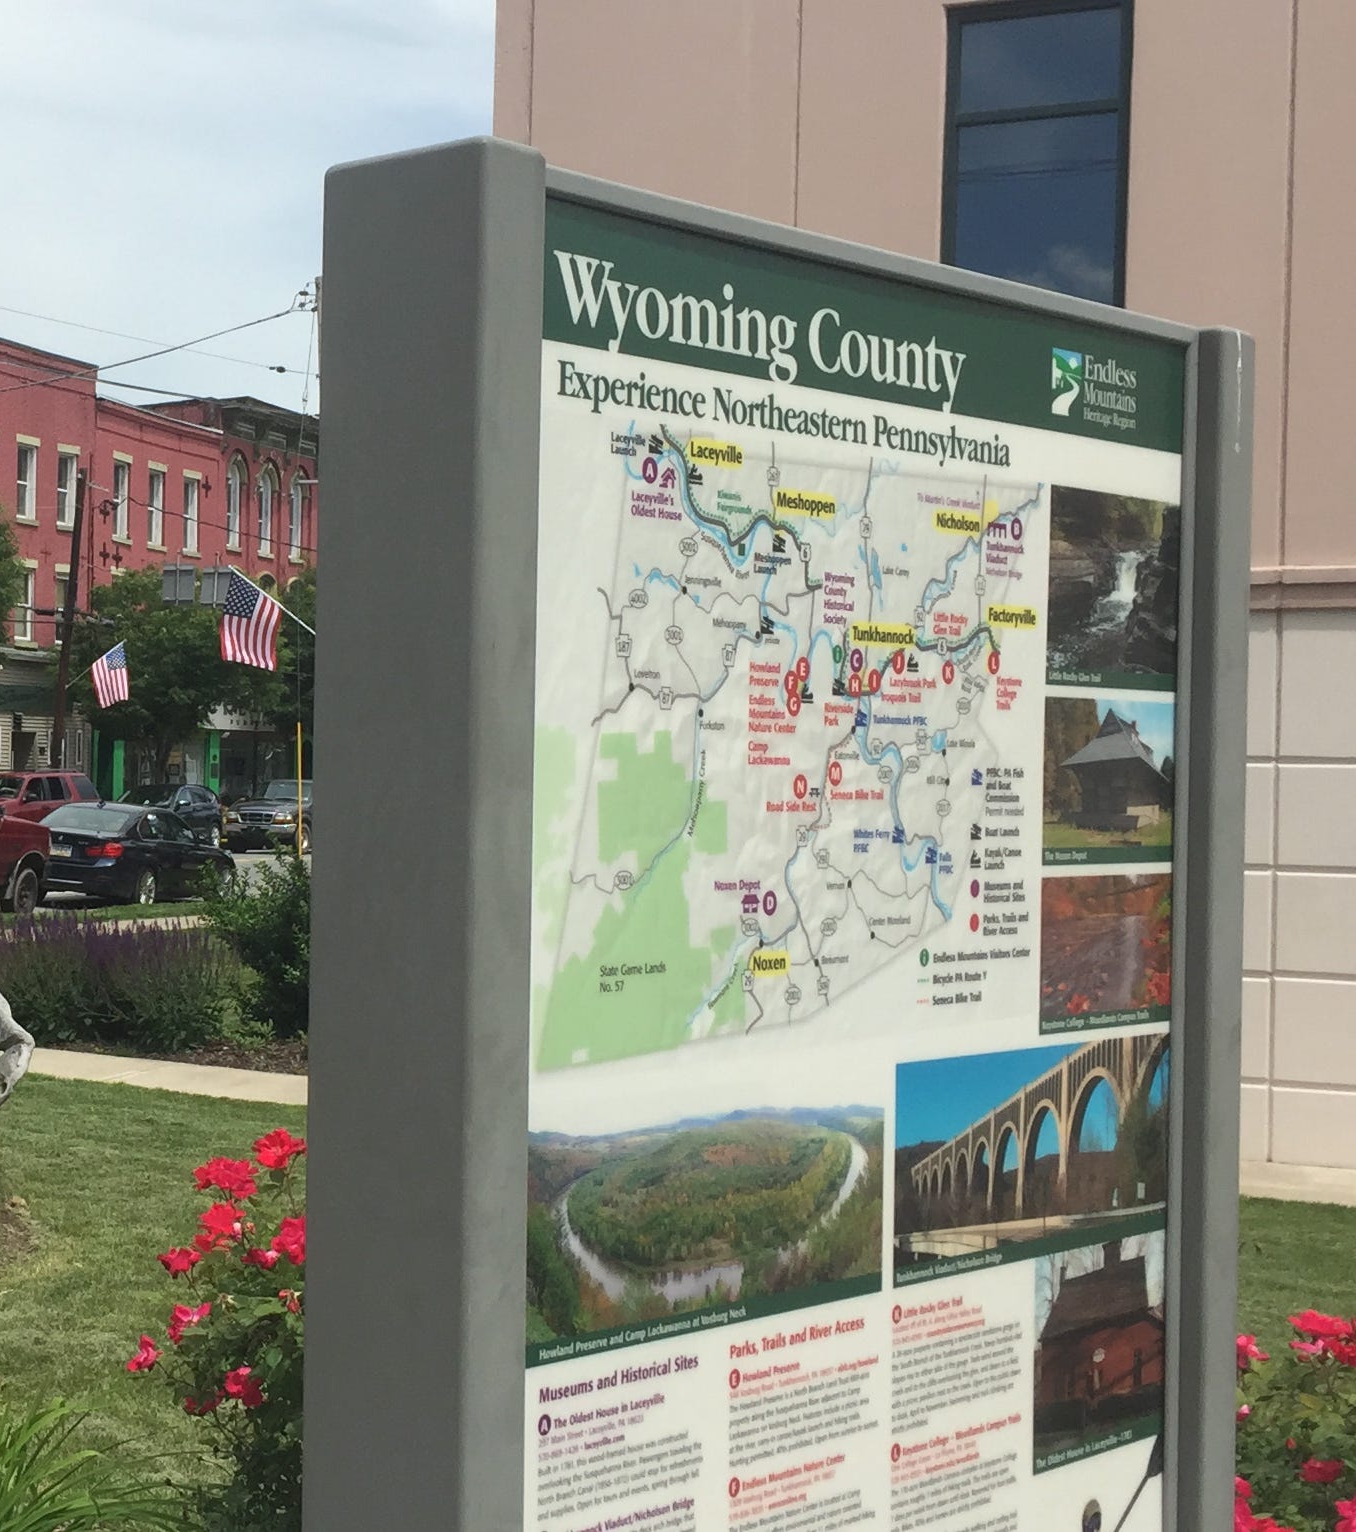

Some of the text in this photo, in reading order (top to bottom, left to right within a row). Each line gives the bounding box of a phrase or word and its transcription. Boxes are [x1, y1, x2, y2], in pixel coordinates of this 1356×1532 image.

[553, 250, 966, 412] Wyoming County
[1084, 354, 1137, 389] Endless
[1083, 380, 1137, 414] Mountains
[557, 359, 1012, 468] Experience Northeastern Pennsylvania
[1083, 407, 1137, 430] Heritage Region
[690, 442, 743, 466] Laceyville
[631, 490, 674, 507] Laceyville's
[776, 491, 836, 517] Meshoppen
[631, 506, 683, 521] Oldest House
[936, 512, 980, 532] Nicholson
[824, 572, 855, 587] Wyoming
[824, 584, 848, 598] County
[988, 607, 1037, 628] Factoryville
[852, 626, 915, 645] Tunkhannock
[749, 661, 781, 674] Howland
[749, 676, 779, 688] Preserve
[749, 693, 775, 706] Endless
[748, 708, 785, 720] Mountains
[824, 715, 839, 727] Park
[748, 722, 796, 734] Nature Center
[748, 741, 769, 754] Camp
[870, 789, 884, 801] Trail
[766, 801, 783, 812] Road
[714, 879, 761, 892] Noxen Depot
[600, 961, 666, 978] State Game Lands
[753, 956, 786, 971] Noxen
[600, 980, 625, 993] No. 57
[539, 1342, 574, 1360] Howland
[575, 1336, 608, 1353] Preserve
[609, 1332, 624, 1345] and
[625, 1328, 646, 1344] Camp
[647, 1319, 691, 1338] Lackawanna
[729, 1305, 747, 1319] Neck
[729, 1317, 865, 1359] Parks, Trails and River Access
[539, 1353, 699, 1405] Museums and Historical Sites
[554, 1417, 567, 1429] The
[569, 1411, 594, 1426] Oldest
[595, 1406, 619, 1420] House
[630, 1393, 665, 1410] Laceyville
[672, 1496, 695, 1511] Bridge
